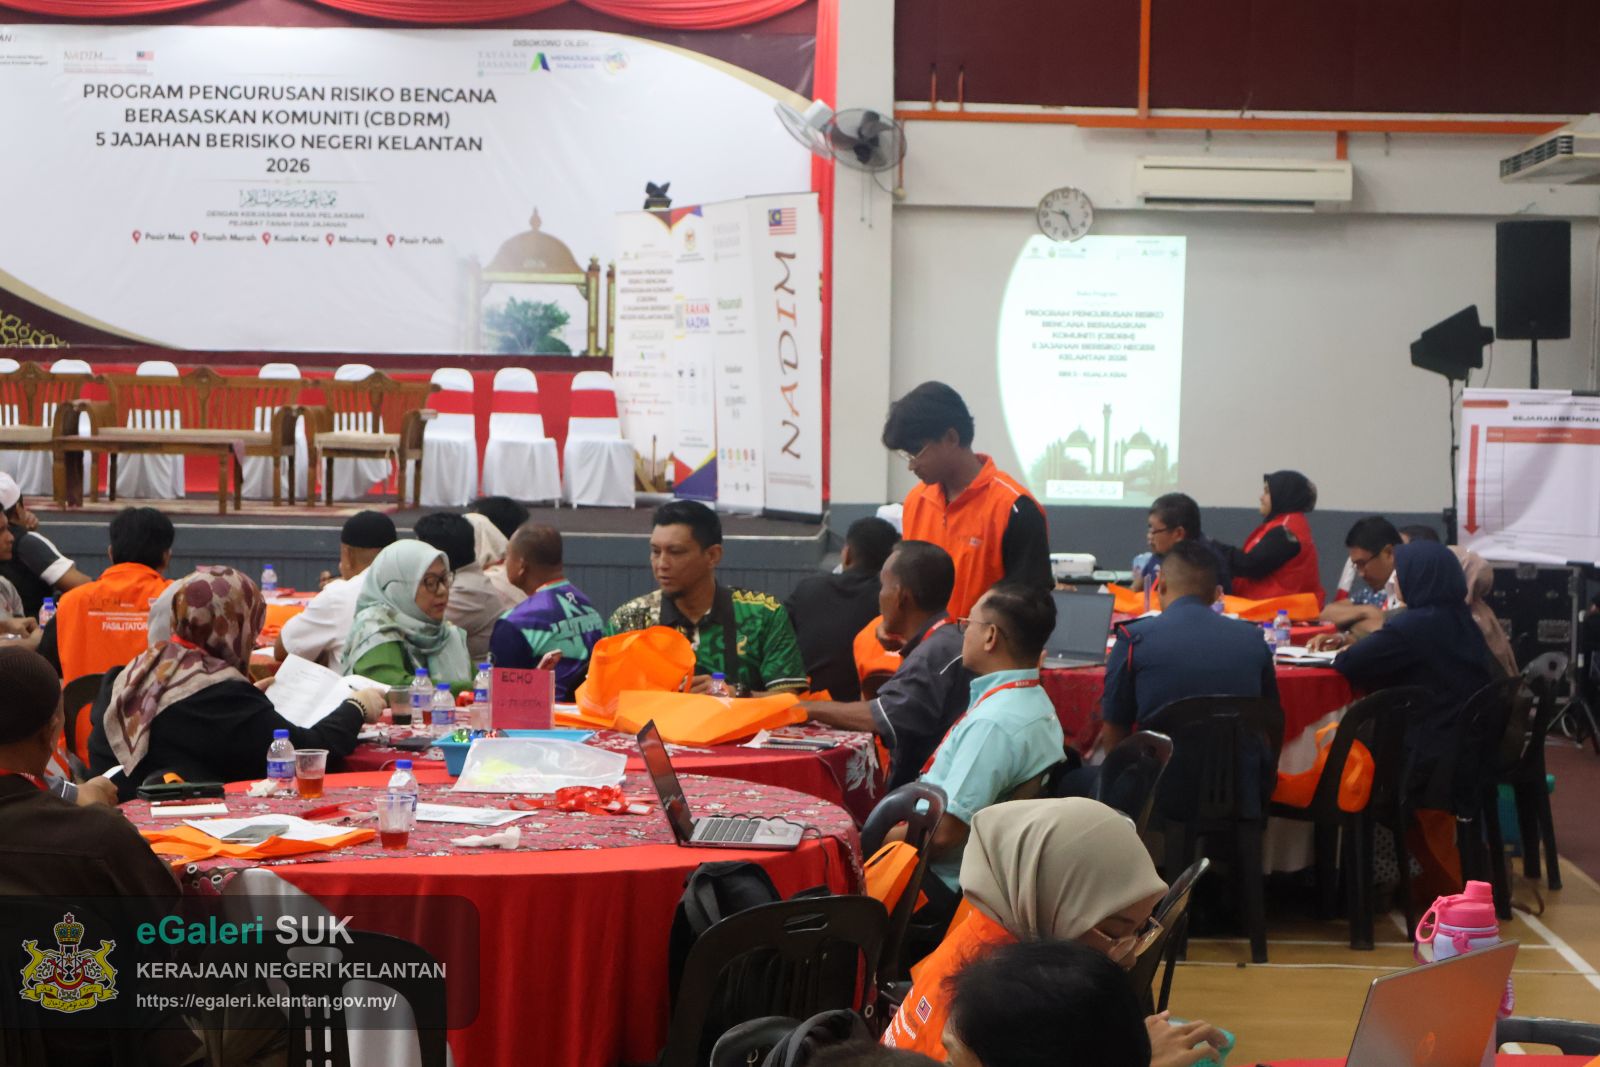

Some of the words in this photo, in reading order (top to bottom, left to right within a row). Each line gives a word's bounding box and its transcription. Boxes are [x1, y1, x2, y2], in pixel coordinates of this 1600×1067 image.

[83, 83, 184, 100] PROGRAM
[189, 85, 326, 102] PENGURUSAN
[331, 86, 395, 103] RISIKO
[400, 86, 498, 104] BENCANA
[125, 108, 257, 125] BERASASKAN
[262, 110, 359, 126] KOMUNITI
[364, 110, 451, 130] (CBDRM)
[95, 132, 107, 147] 5
[111, 132, 201, 148] JAJAHAN
[205, 133, 296, 149] BERISIKO
[301, 135, 373, 151] NEGERI
[378, 136, 483, 152] KELANTAN
[265, 157, 311, 174] 2026
[774, 250, 801, 460] NADIM
[1558, 415, 1600, 423] BENCAN
